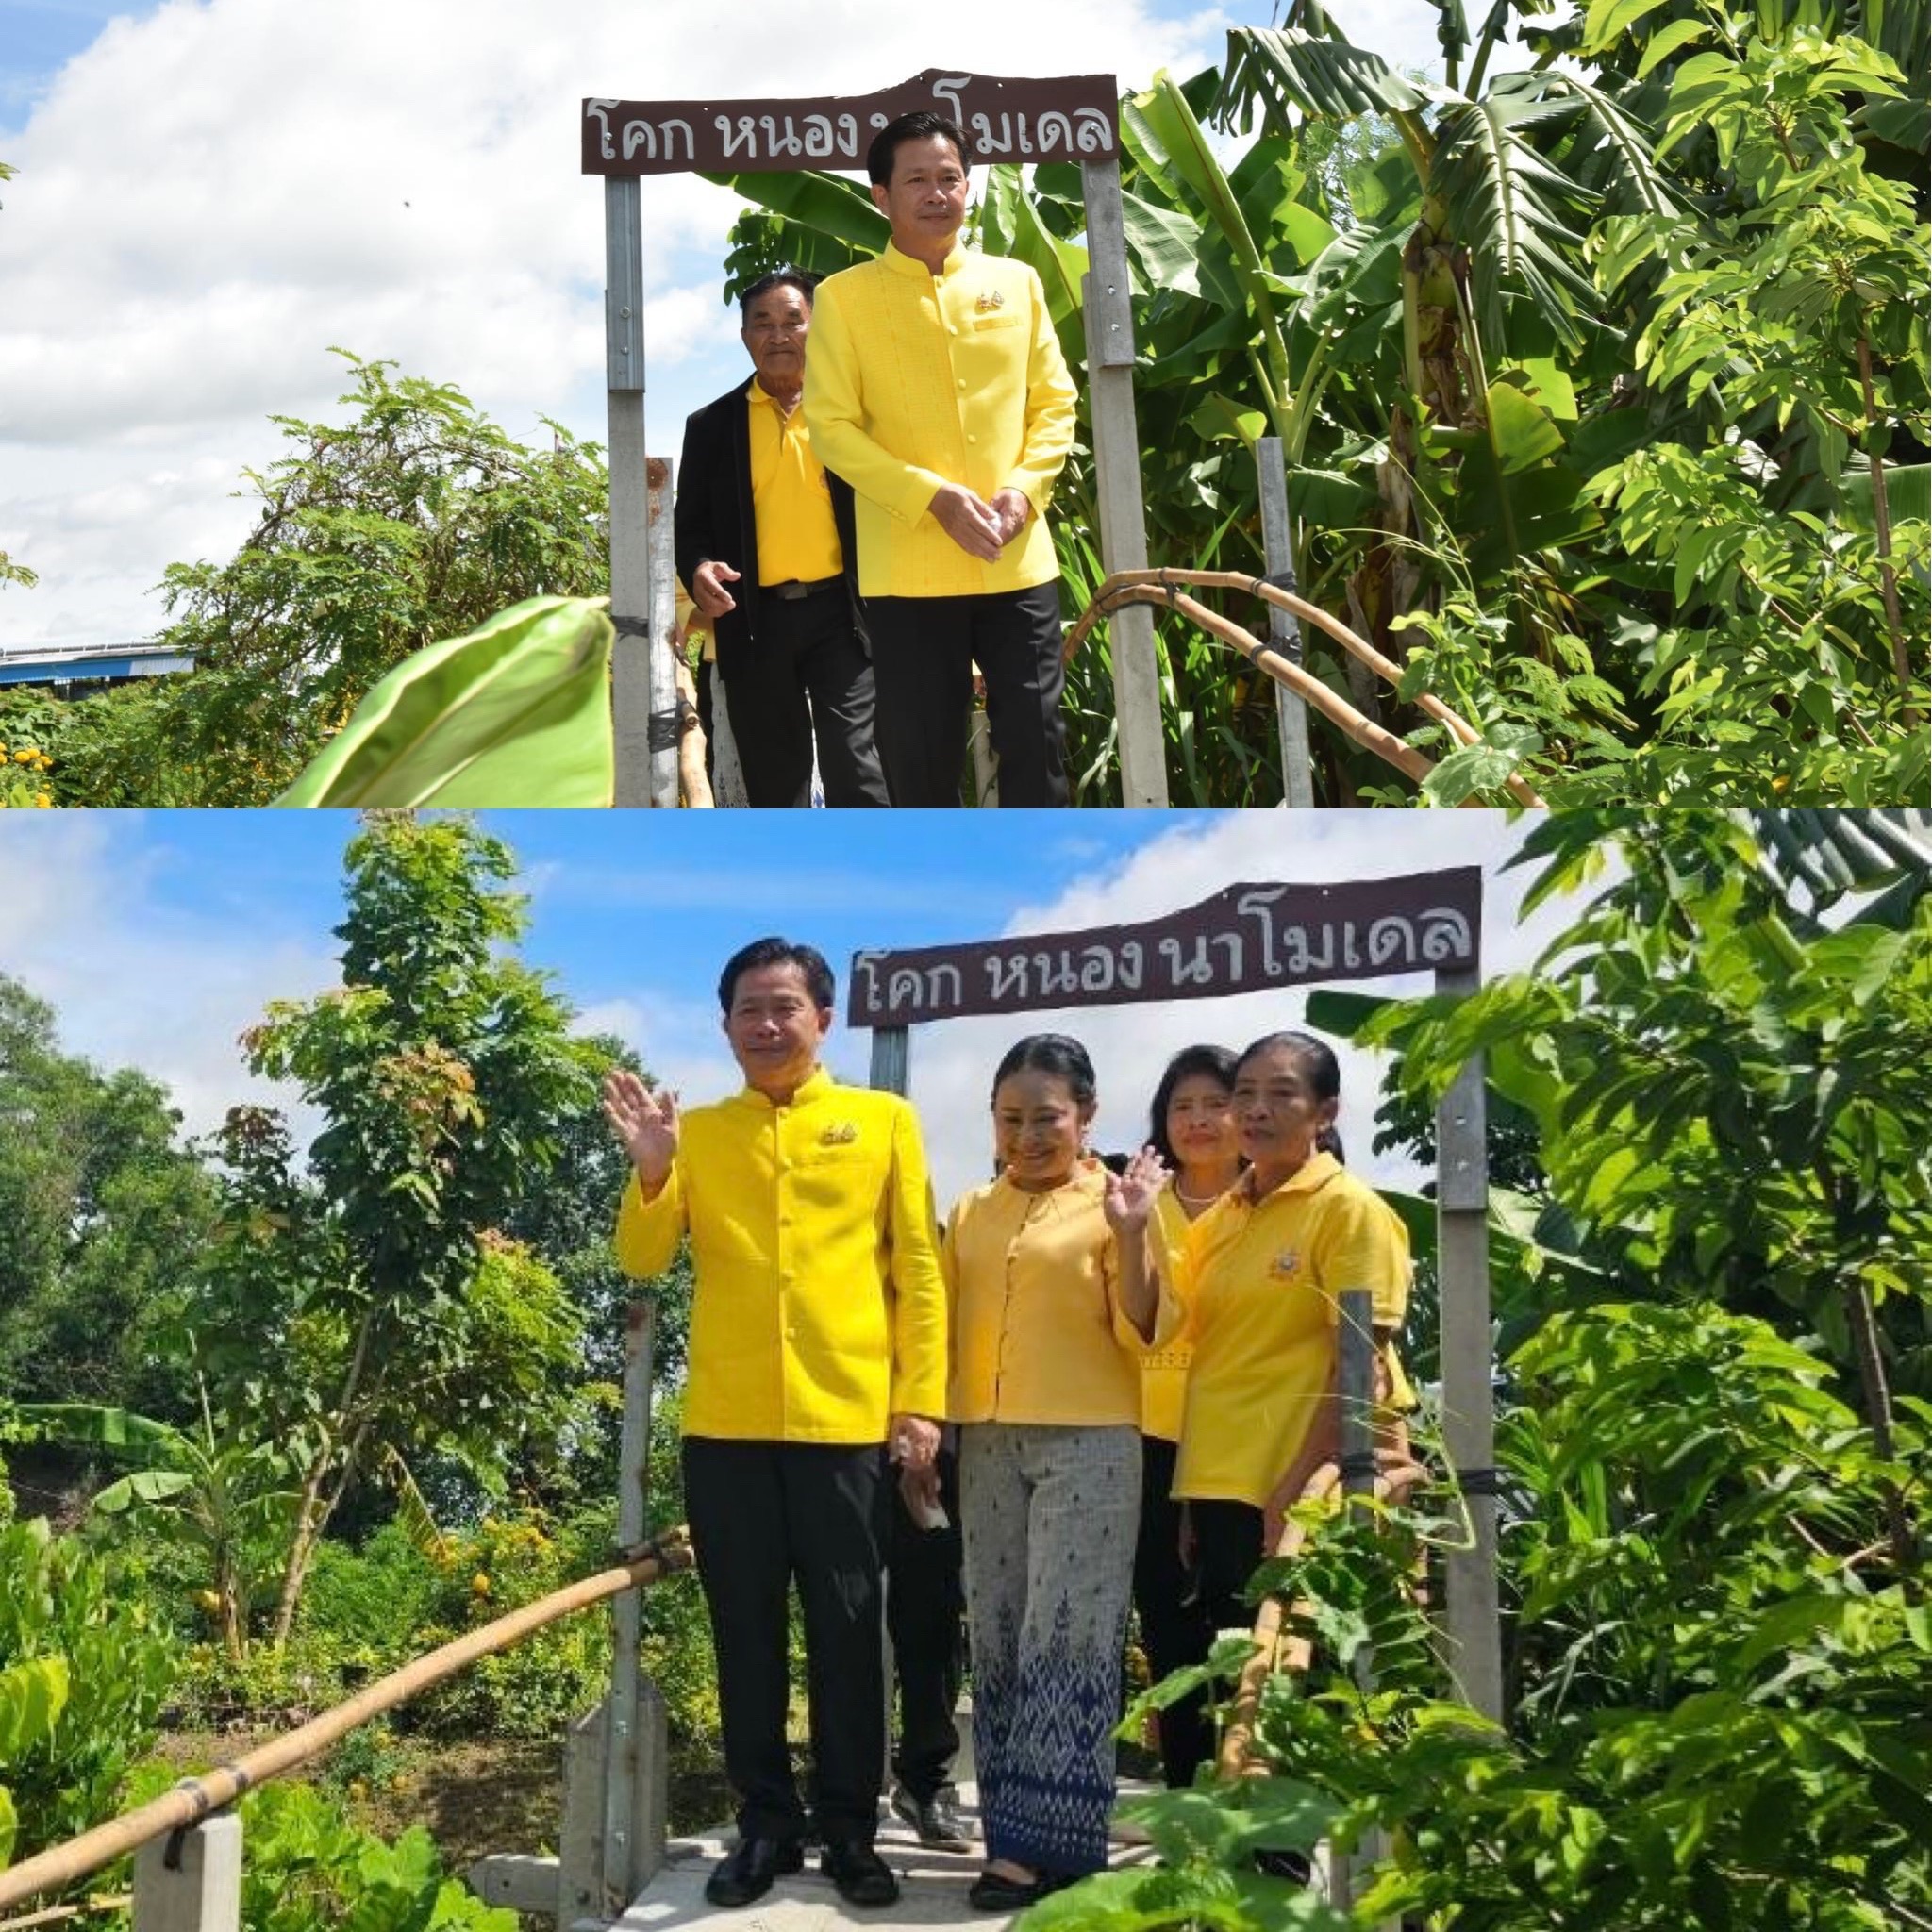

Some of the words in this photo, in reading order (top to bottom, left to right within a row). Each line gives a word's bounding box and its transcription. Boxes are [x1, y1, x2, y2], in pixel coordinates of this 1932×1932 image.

[586, 98, 695, 161] โคก
[714, 113, 858, 158] หนอง
[854, 949, 962, 1012] โคก
[984, 940, 1144, 1000] หนอง
